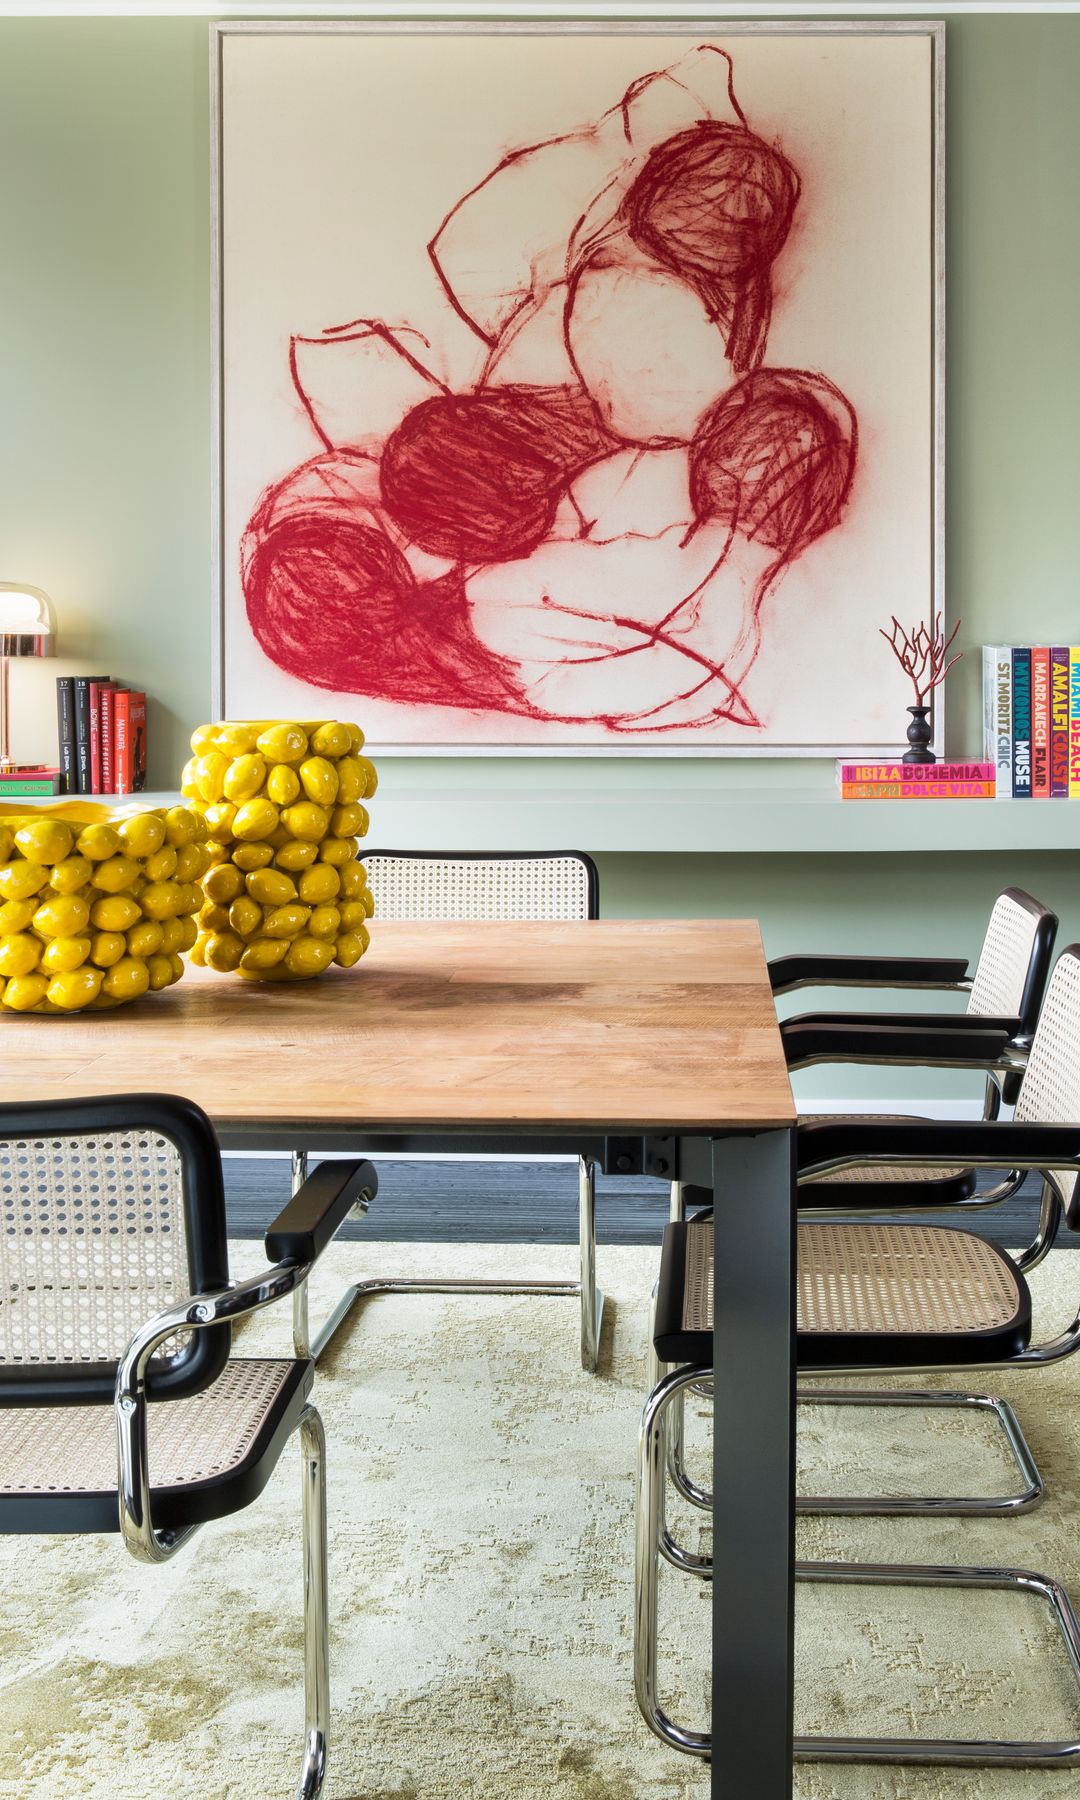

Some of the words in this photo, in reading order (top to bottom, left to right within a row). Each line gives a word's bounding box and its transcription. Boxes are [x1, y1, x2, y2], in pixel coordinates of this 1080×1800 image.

[997, 662, 1010, 681] ST.
[997, 683, 1010, 735] MORITZ
[1014, 662, 1029, 741] MYKONOS
[1034, 663, 1047, 746] MARRAKECH
[1052, 663, 1068, 731] AMALFI
[856, 766, 900, 781] IBIZA
[903, 766, 983, 781] BOHEMIA
[997, 736, 1011, 769] CHIC
[1015, 741, 1030, 785] MUSE
[1035, 748, 1047, 787] FLAIR
[1052, 732, 1068, 785] COAST
[856, 784, 899, 797] CAPRI
[902, 784, 947, 796] DOLCE
[950, 783, 984, 796] VITA
